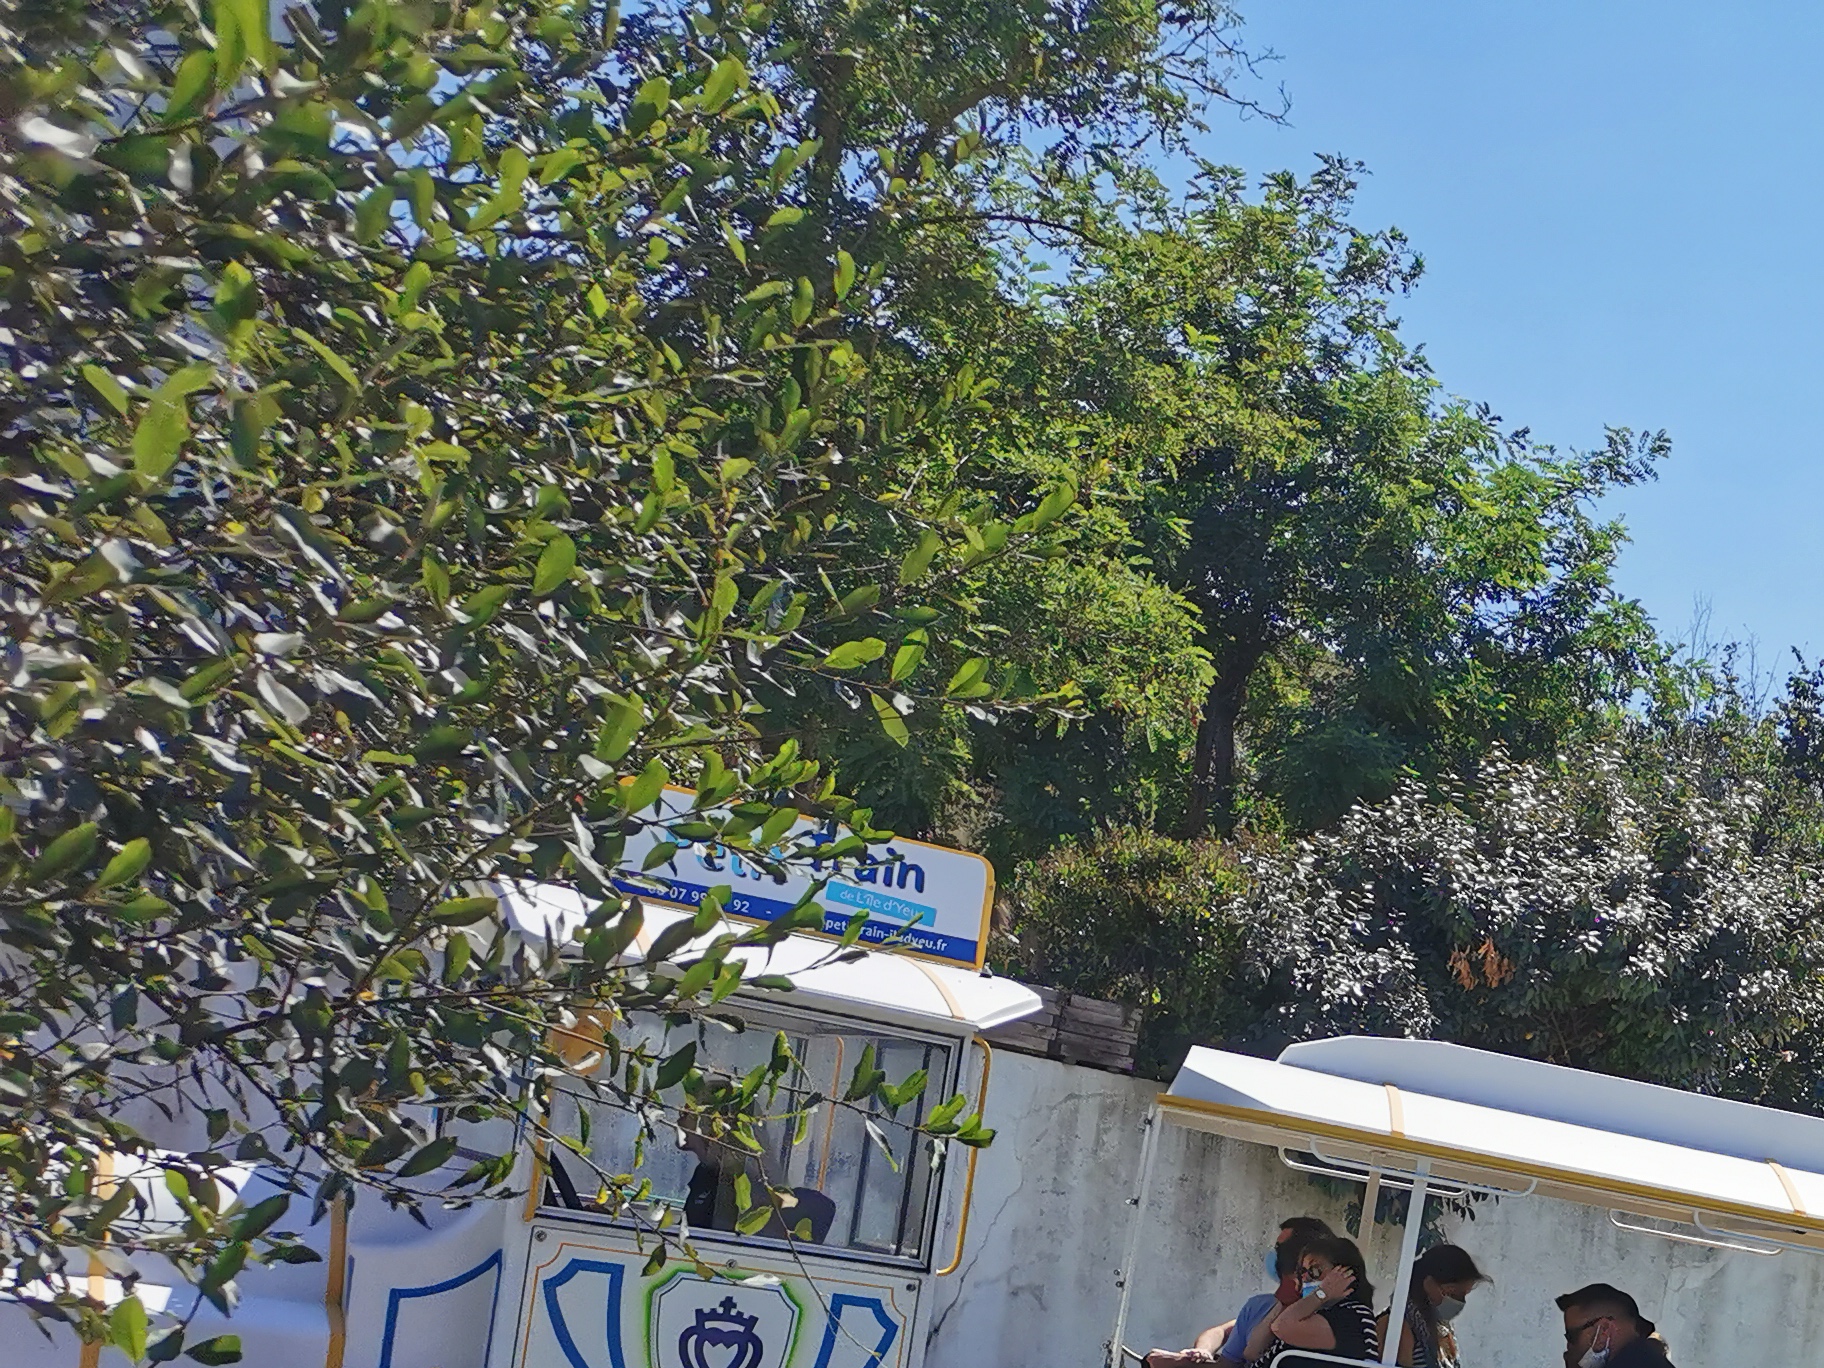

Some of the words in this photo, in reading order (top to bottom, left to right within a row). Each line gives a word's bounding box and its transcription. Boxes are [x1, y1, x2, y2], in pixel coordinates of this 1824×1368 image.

[669, 886, 688, 901] 07
[733, 899, 750, 913] 92
[839, 889, 855, 901] de
